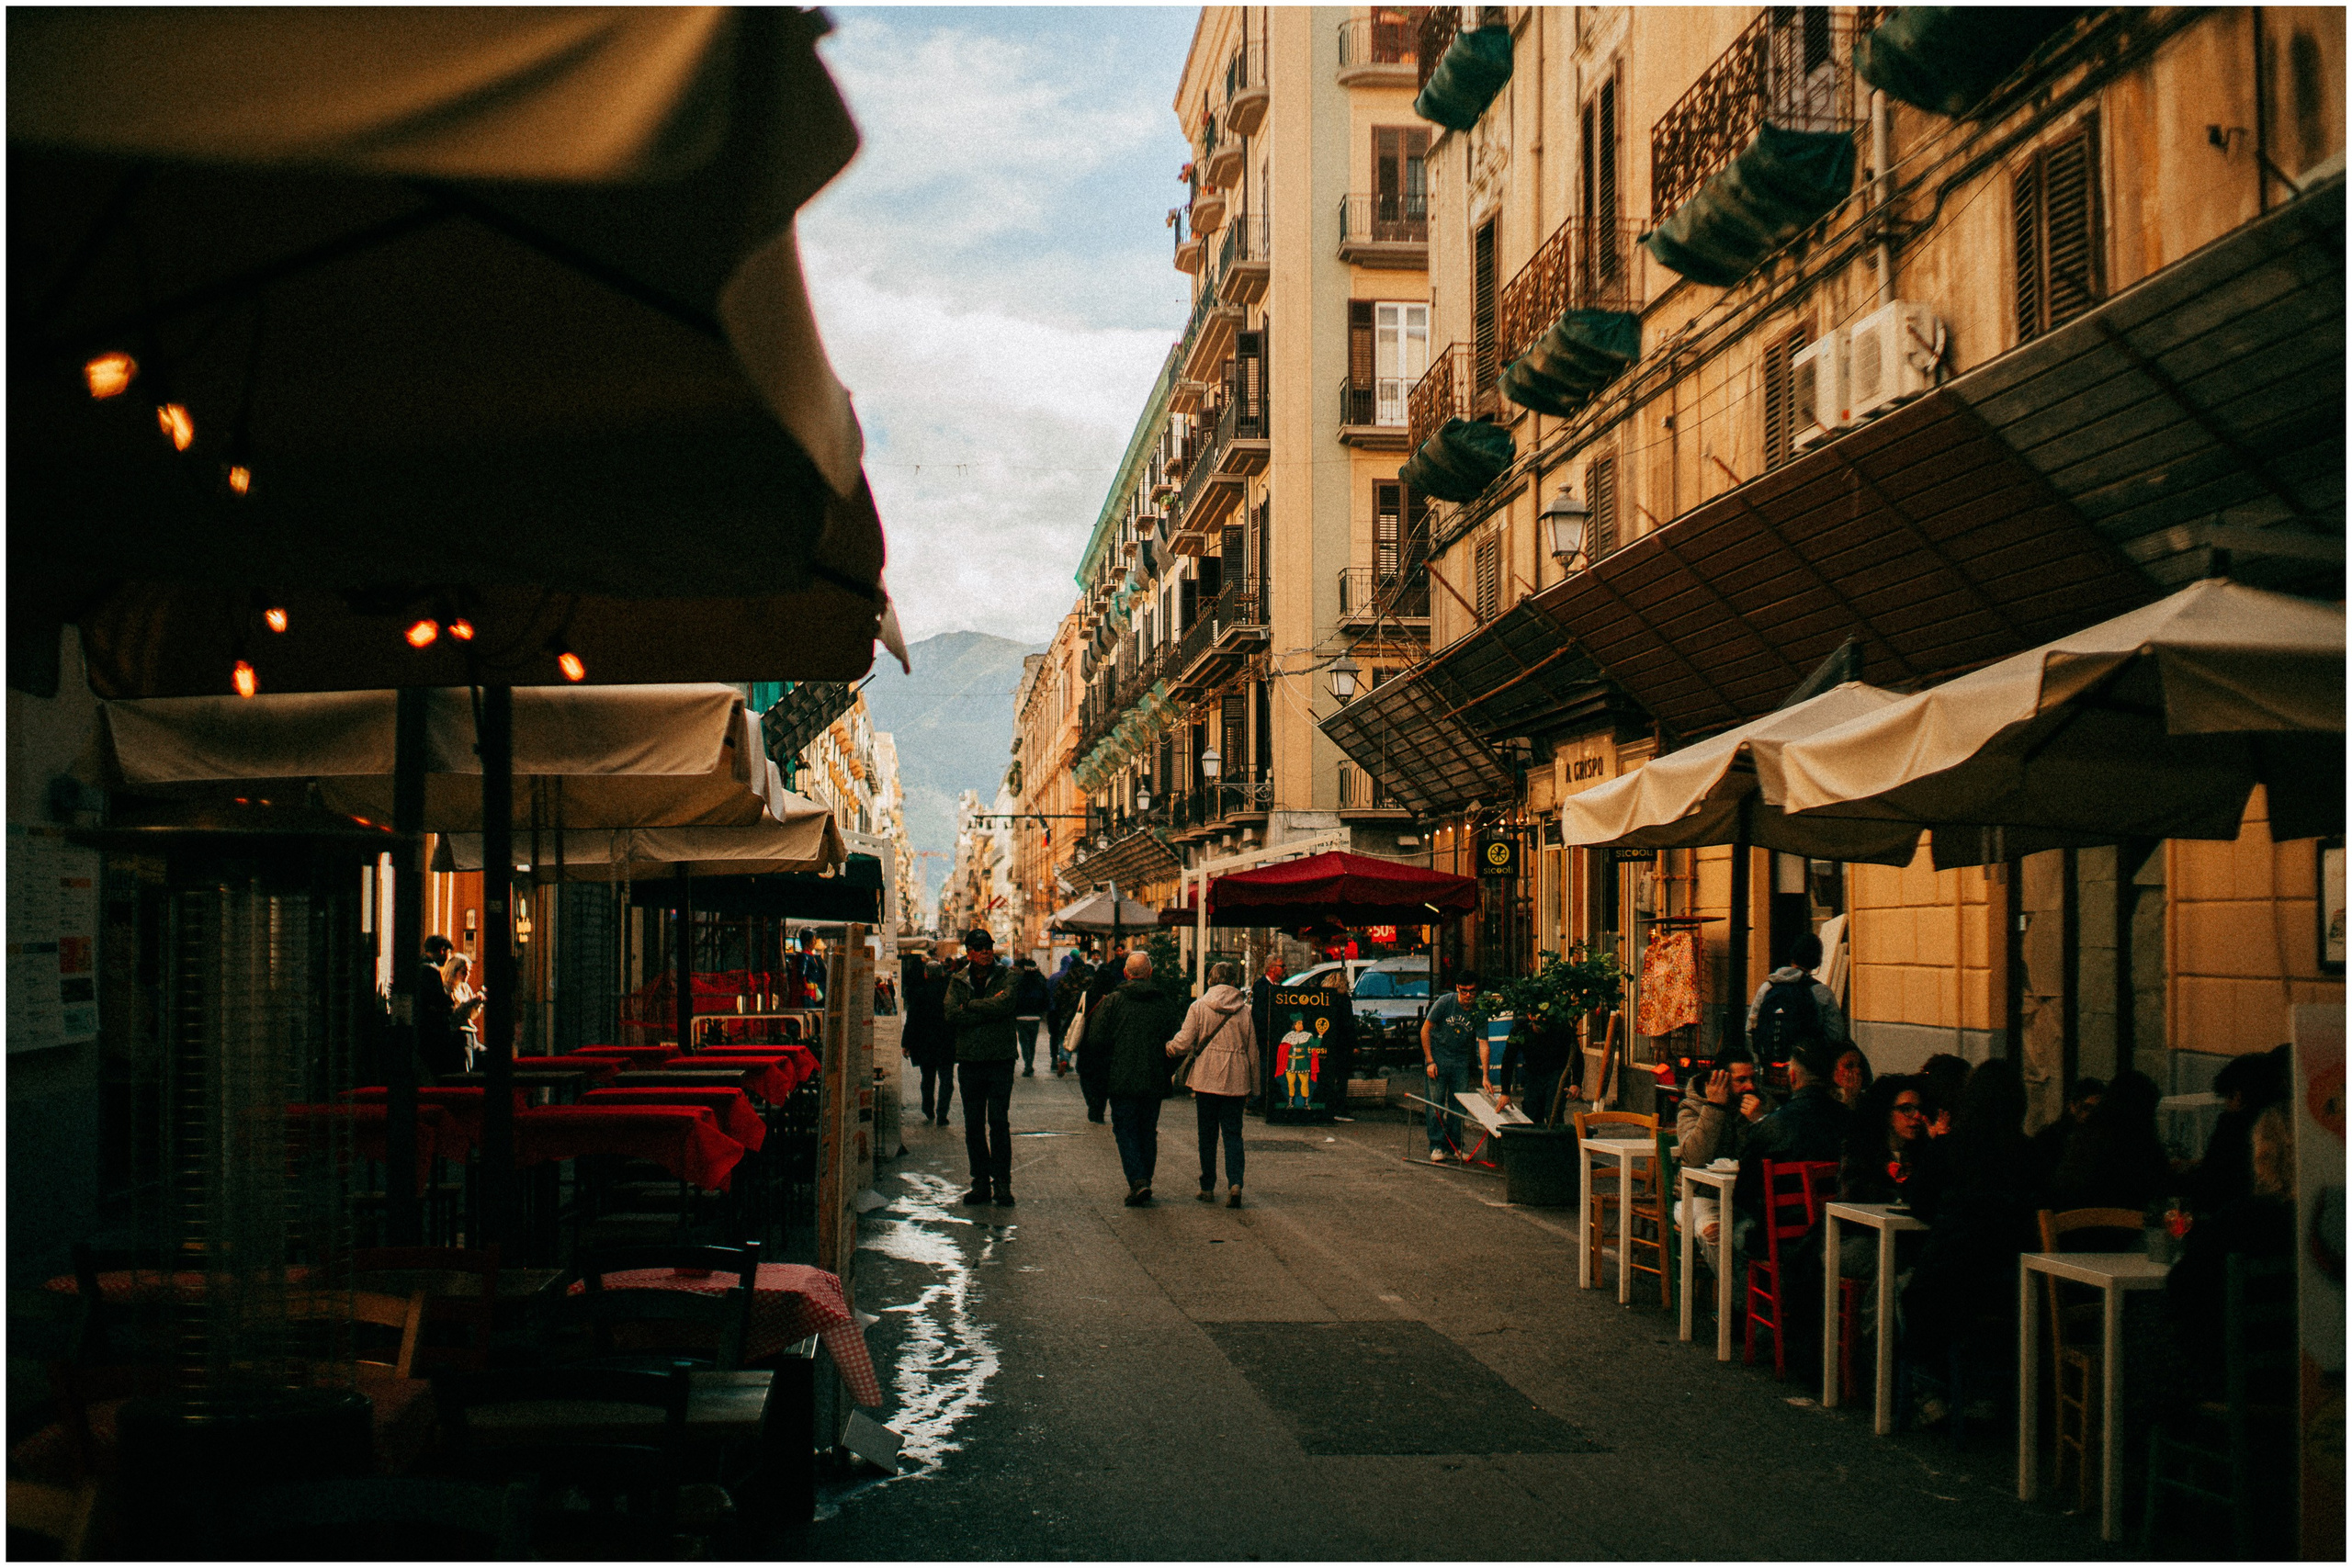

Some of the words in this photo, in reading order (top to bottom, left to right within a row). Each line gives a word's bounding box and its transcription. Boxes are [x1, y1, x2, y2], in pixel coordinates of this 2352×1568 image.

[1566, 762, 1572, 784] A
[1574, 756, 1604, 782] CRISPO
[1483, 865, 1514, 874] sicooli
[1373, 925, 1396, 937] 50%
[1275, 990, 1330, 1007] sicooli
